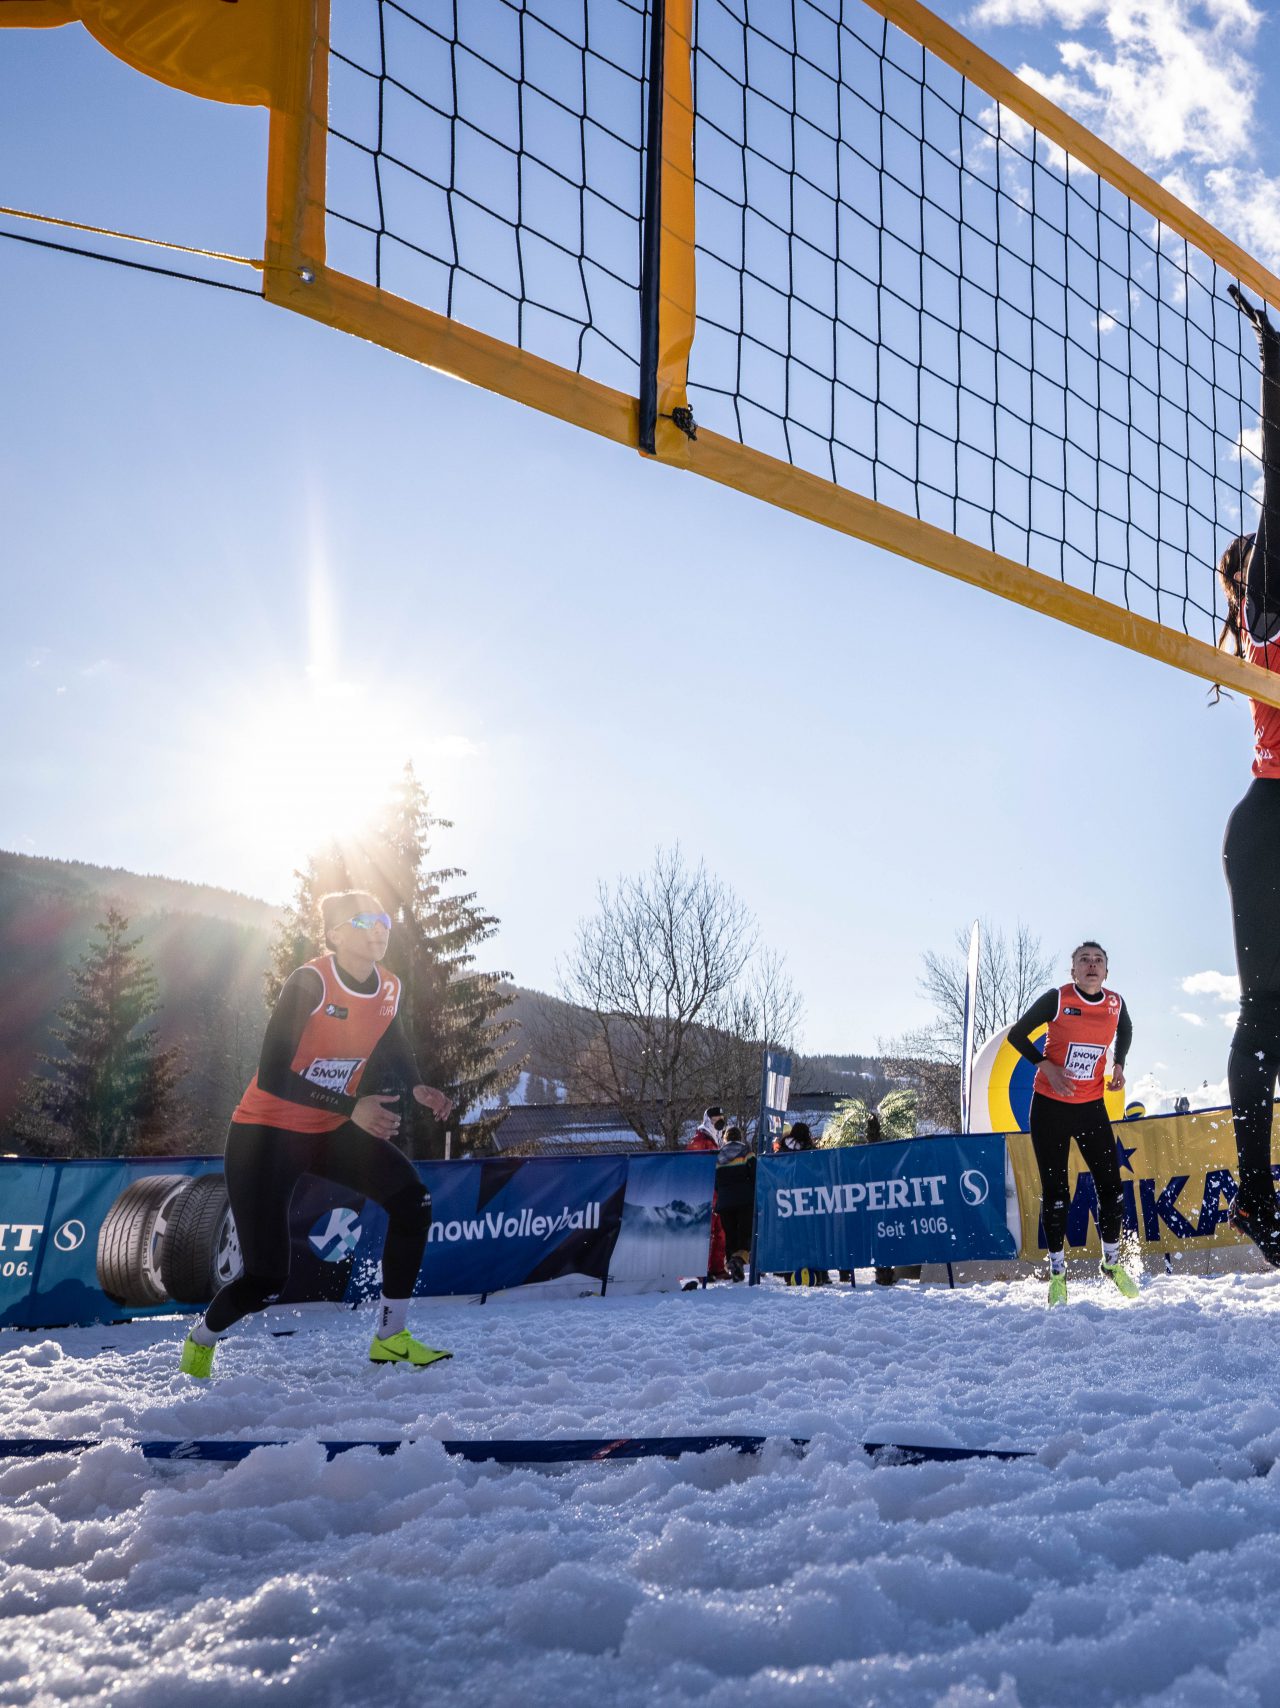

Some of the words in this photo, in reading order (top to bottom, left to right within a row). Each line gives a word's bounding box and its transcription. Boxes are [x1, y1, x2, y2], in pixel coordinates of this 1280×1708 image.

[383, 980, 394, 1001] 2
[1108, 994, 1118, 1007] 3
[1072, 1051, 1098, 1061] SNOW
[311, 1067, 349, 1079] SNOW
[776, 1175, 947, 1218] SEMPERIT
[427, 1202, 600, 1243] nowVolleyball
[877, 1221, 906, 1238] Seit
